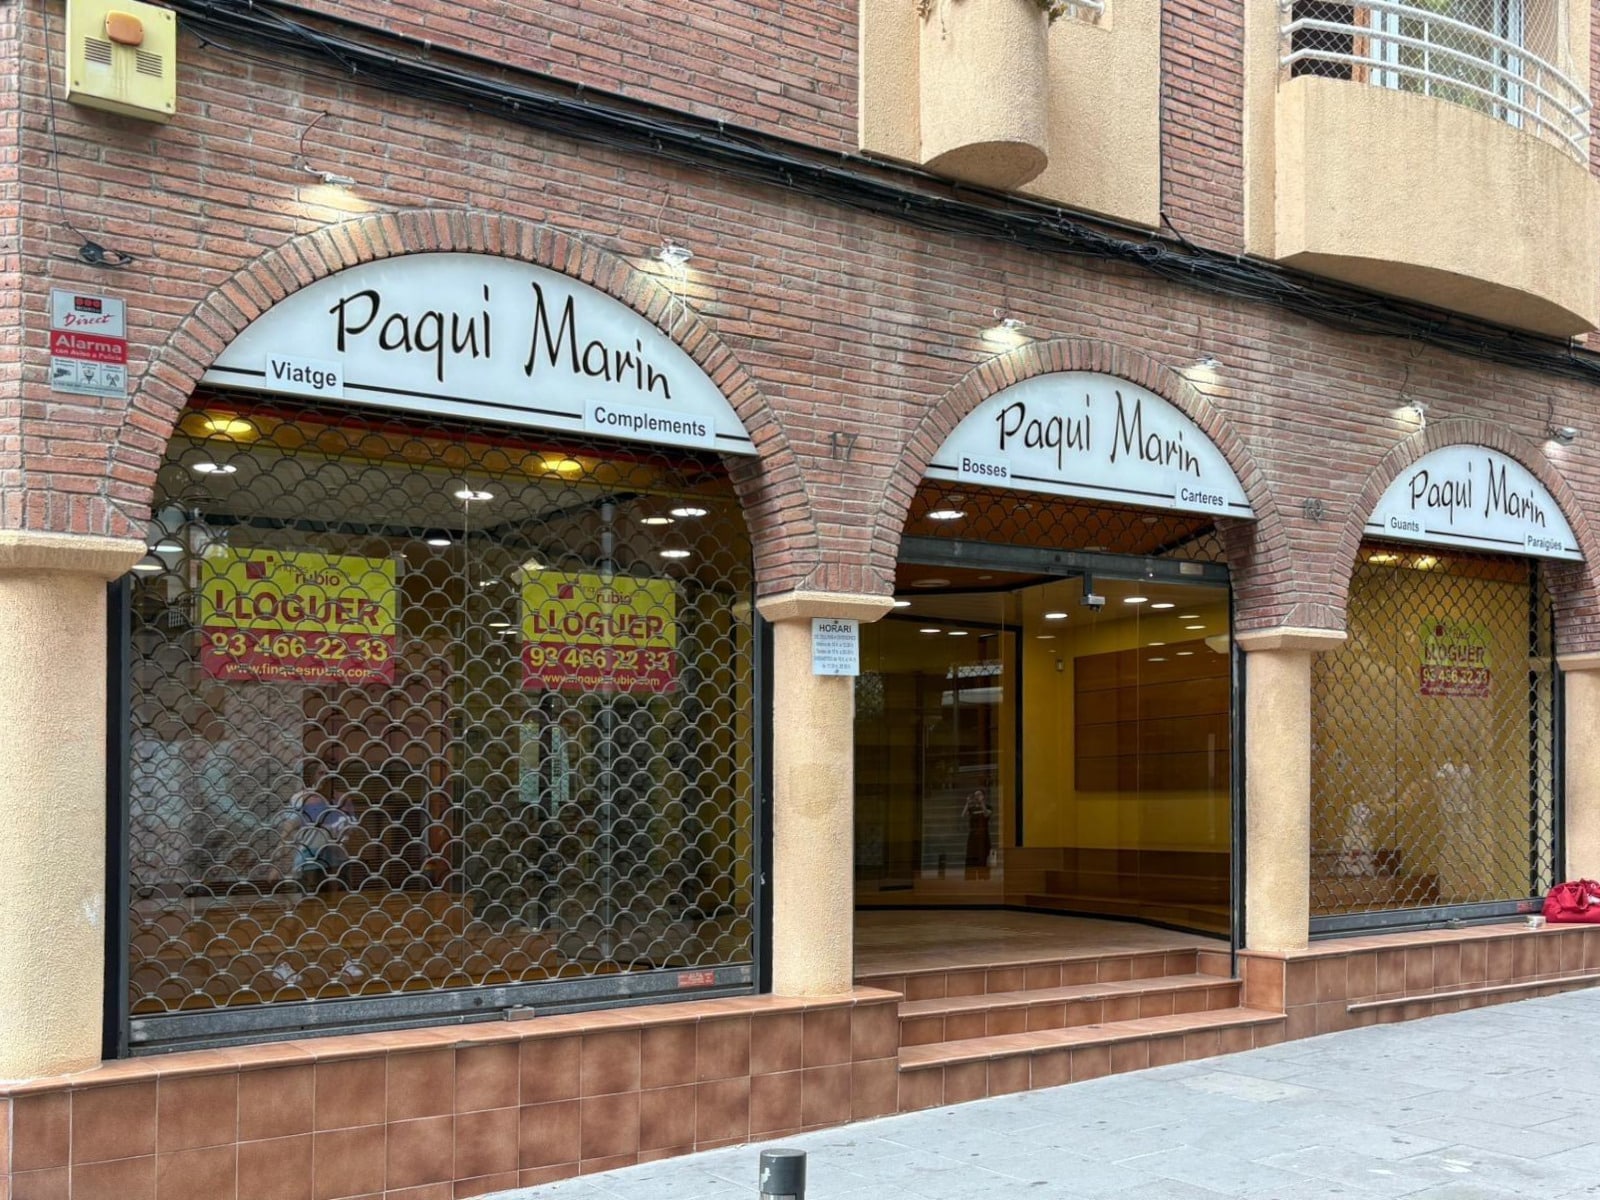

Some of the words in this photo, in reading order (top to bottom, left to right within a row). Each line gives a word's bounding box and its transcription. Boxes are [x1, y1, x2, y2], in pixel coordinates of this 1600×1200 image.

[64, 312, 115, 327] Direct
[56, 335, 122, 354] Alarma
[329, 284, 491, 383] Paqui
[524, 281, 672, 400] Marin
[271, 360, 338, 389] Viatge
[593, 406, 707, 438] Complements
[995, 393, 1091, 471] Paqui
[1110, 389, 1201, 477] Marin
[828, 431, 859, 462] 17
[962, 457, 1008, 478] Bosses
[1180, 487, 1224, 507] Carteres
[1408, 461, 1472, 525] Paqui
[1484, 457, 1547, 528] Marin
[1390, 516, 1420, 533] Guants
[1527, 535, 1563, 551] Paraigües
[215, 589, 380, 627] LLOGUER
[819, 624, 852, 633] HORARI
[211, 632, 247, 657] 93
[253, 634, 306, 658] 466
[313, 636, 347, 661] 22
[355, 638, 389, 662] 33
